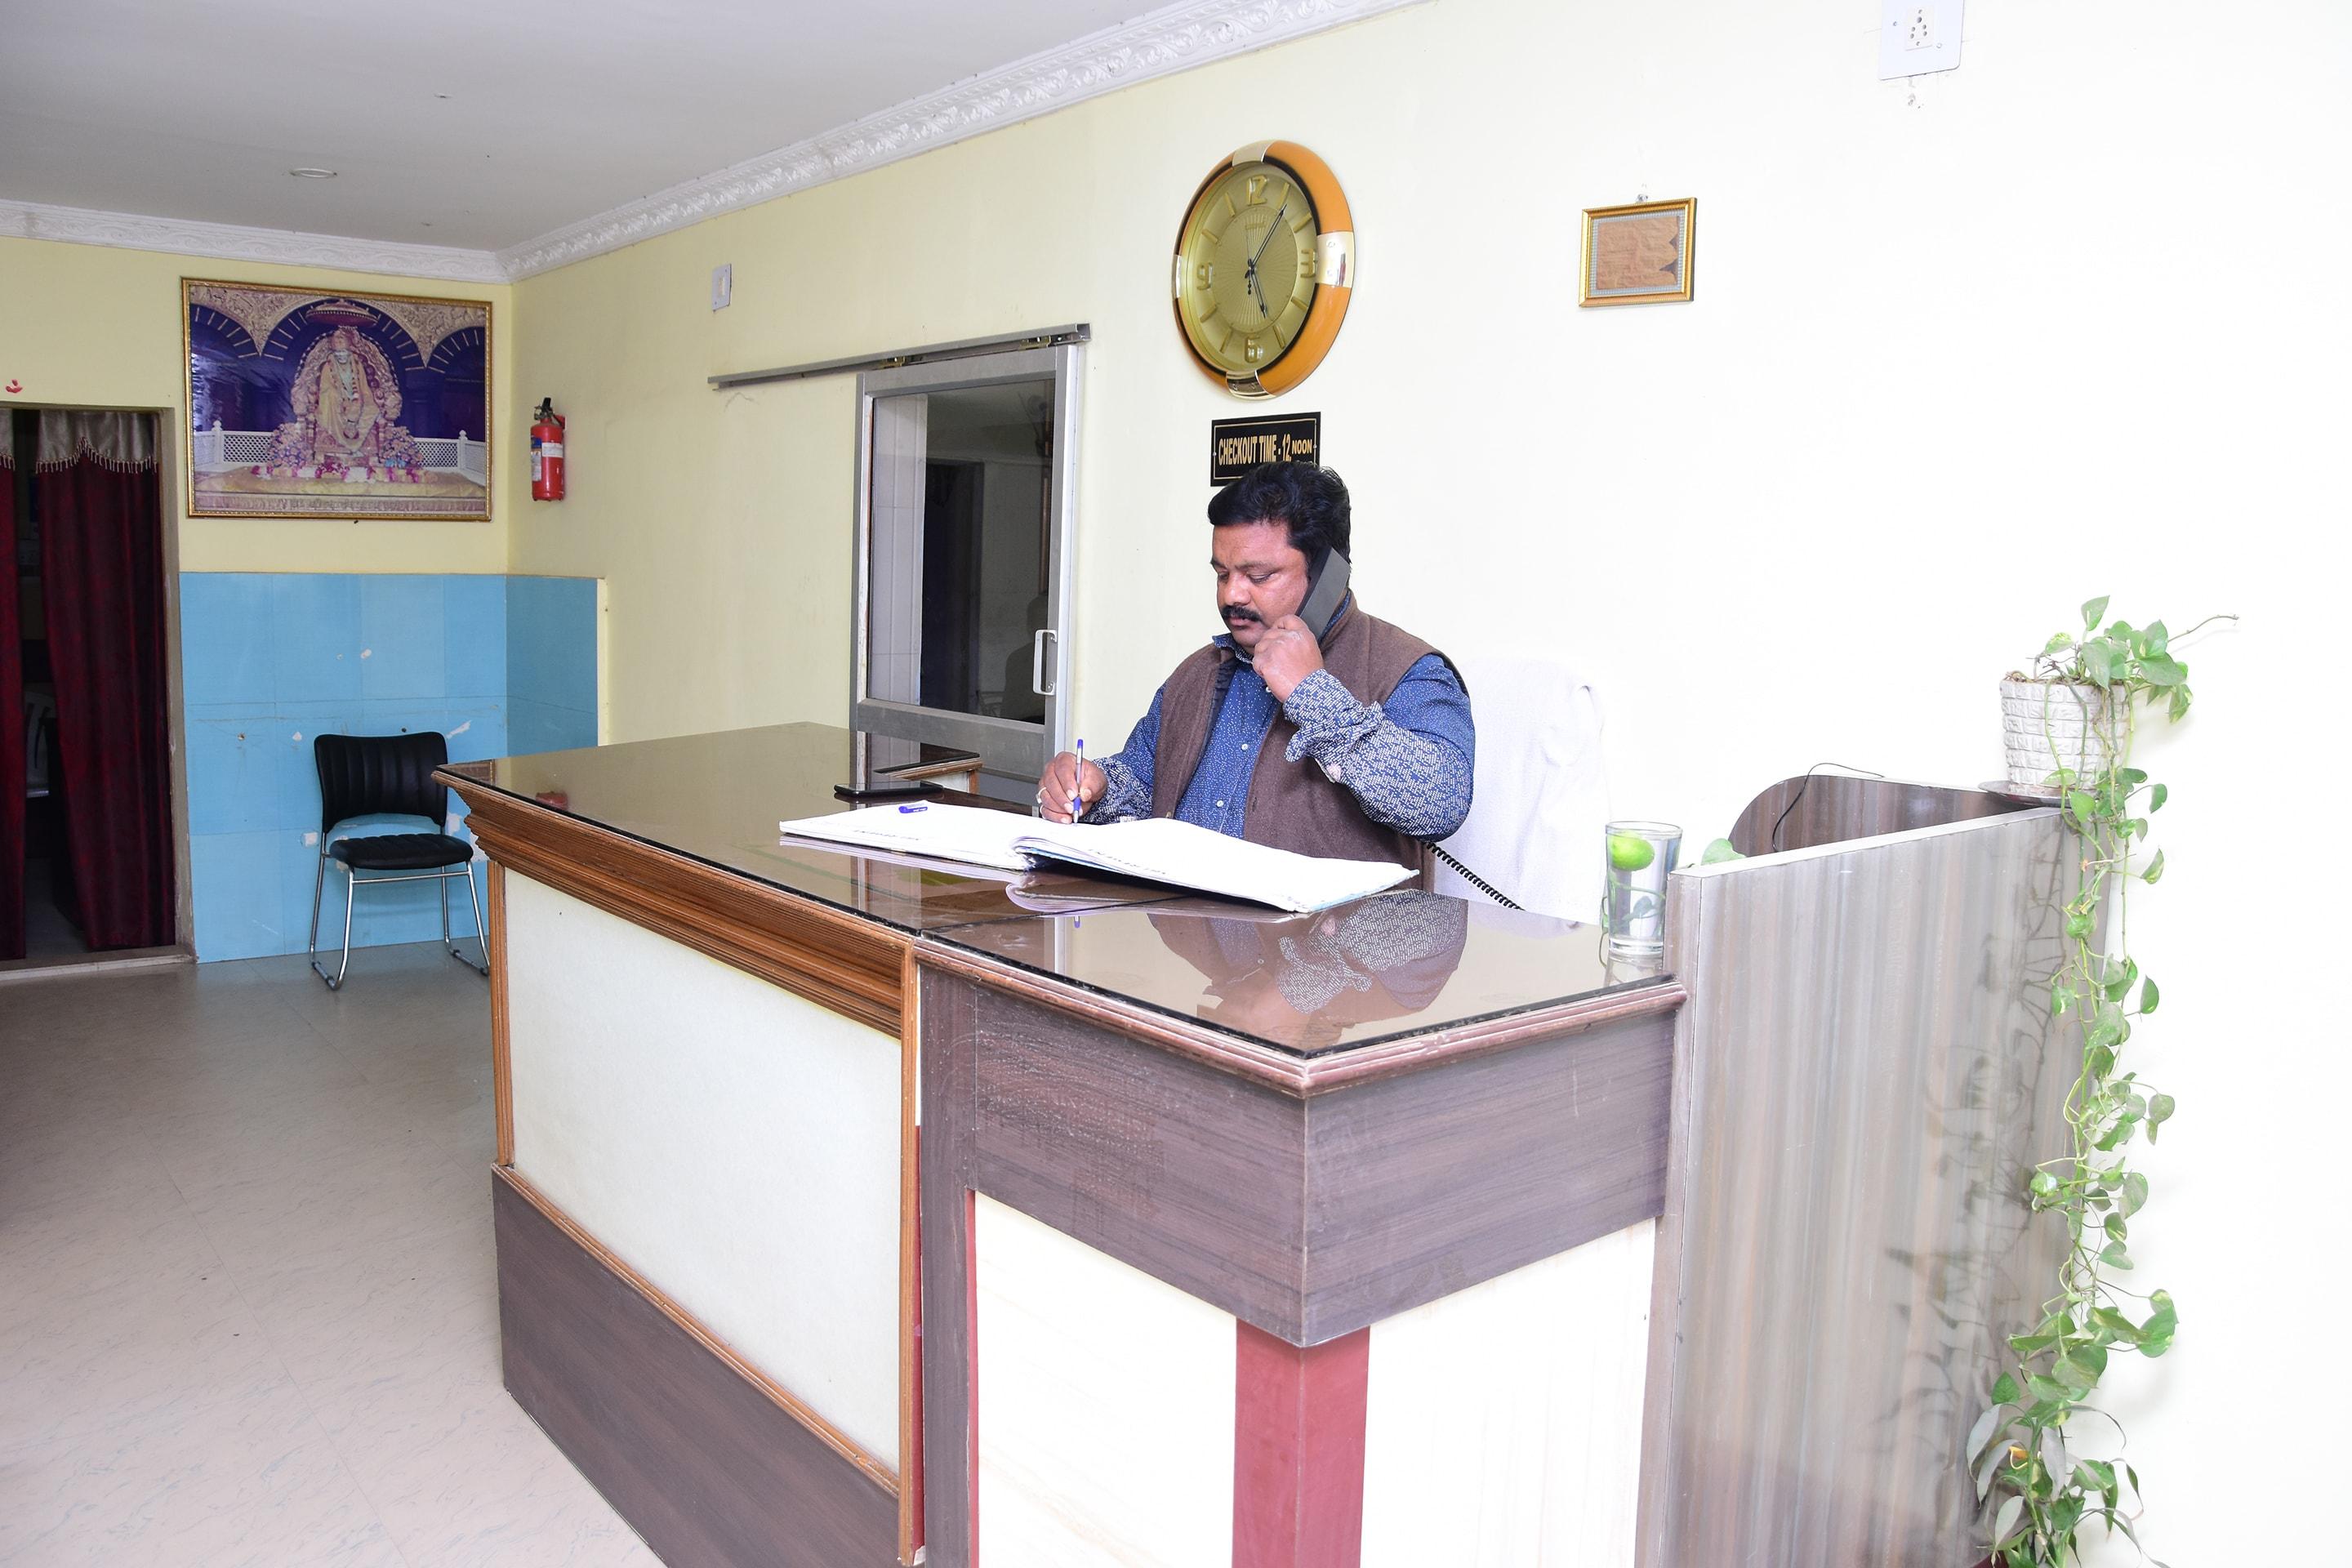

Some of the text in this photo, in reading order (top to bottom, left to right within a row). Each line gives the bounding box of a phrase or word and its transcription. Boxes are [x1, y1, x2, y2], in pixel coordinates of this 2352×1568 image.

[1246, 174, 1267, 206] 12
[1196, 263, 1212, 291] 9
[1300, 247, 1316, 278] 3
[1245, 335, 1263, 363] 6
[1218, 436, 1258, 466] CHECKOUT
[1258, 434, 1277, 463] TIME
[1282, 434, 1292, 463] 12
[1292, 439, 1312, 455] NOON
